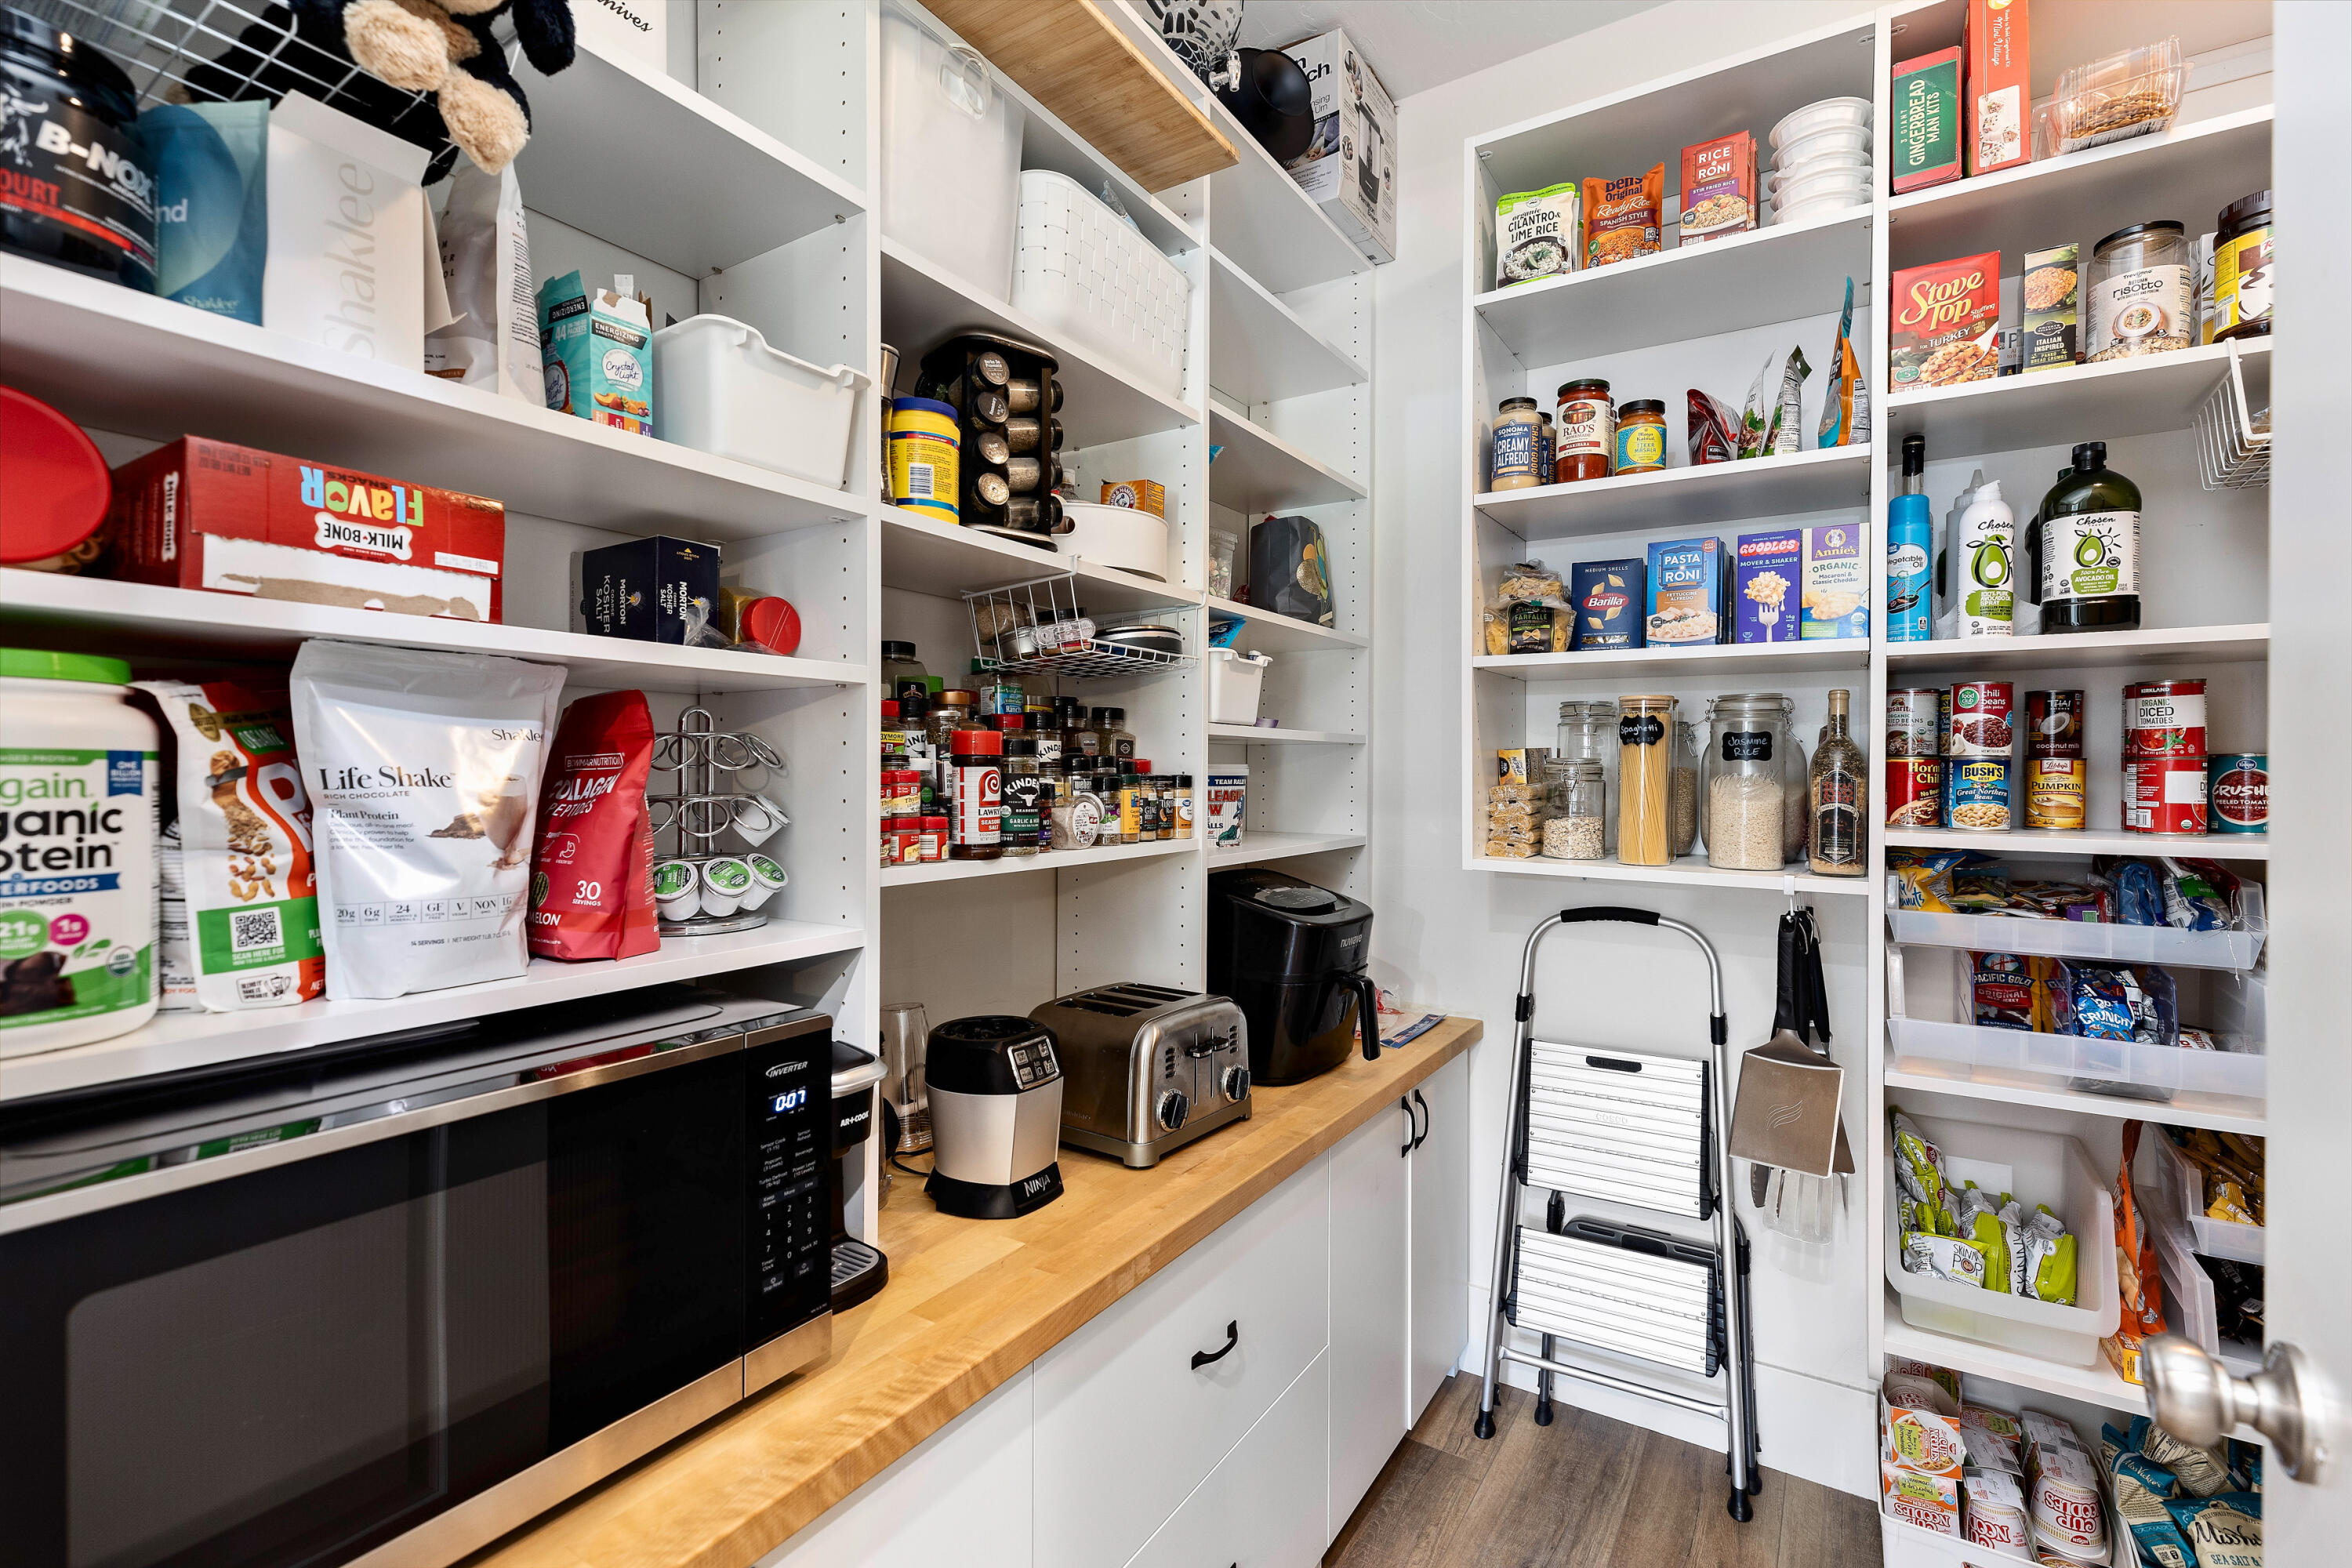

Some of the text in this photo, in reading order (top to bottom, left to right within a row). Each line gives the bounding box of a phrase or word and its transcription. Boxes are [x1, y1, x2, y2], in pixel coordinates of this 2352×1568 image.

[597, 0, 653, 32] nives
[1991, 16, 2004, 67] Mini Village
[1314, 102, 1328, 114] Urn
[1908, 78, 1926, 167] GINGERBREAD
[1926, 91, 1940, 144] MAN KITS
[1698, 147, 1731, 165] RICE
[1698, 162, 1731, 180] RONI
[0, 169, 61, 206] OURT
[1605, 185, 1643, 202] Original
[1704, 183, 1722, 192] FRIED
[1512, 207, 1542, 222] organic
[1597, 196, 1652, 218] Ready Rice
[1508, 211, 1555, 233] CILANTRO
[1599, 210, 1649, 227] SPANISH STYLE
[1511, 221, 1559, 244] LIME RICE
[323, 162, 376, 361] Shaklee
[2128, 277, 2149, 286] AUTUMN
[2112, 280, 2164, 299] risotto
[1900, 271, 1984, 325] Stove
[552, 300, 586, 319] ENERGIZING
[1927, 297, 1973, 332] Top
[1969, 302, 1996, 318] Stuffing
[1972, 313, 1985, 321] Mix
[555, 324, 566, 342] 44
[594, 322, 640, 343] ENERGIZING
[1929, 325, 1972, 349] TURKEY
[2034, 342, 2065, 354] INSPIRED
[2036, 336, 2063, 347] ITALIAN
[2048, 354, 2068, 362] CRUMBS
[605, 360, 636, 376] Crystal
[1498, 426, 1529, 436] SONOMA
[1563, 423, 1595, 437] RAO'S
[1497, 437, 1530, 453] CREAMY
[1530, 425, 1540, 474] CRAZY GOOD
[1497, 452, 1530, 467] ALFREDO
[325, 470, 389, 490] SNACKS
[1978, 519, 2015, 531] Chosen
[2076, 516, 2116, 526] Chosen
[1739, 539, 1798, 554] GOODLES
[1814, 546, 1857, 560] Annie's
[1664, 552, 1701, 566] PASTA
[1740, 556, 1798, 568] MOVER SHAKER
[1812, 561, 1859, 574] ORGANIC
[1665, 568, 1701, 583] RONI
[1833, 576, 1859, 585] Cheddar
[2074, 575, 2105, 583] AVOCADO
[679, 581, 688, 621] MORTON
[1588, 596, 1626, 608] Barilla
[1514, 612, 1548, 622] FARFALLE
[1981, 689, 2001, 698] chili
[1981, 697, 2007, 706] beans
[2141, 698, 2171, 706] ORGANIC
[2140, 706, 2175, 717] DICED
[2140, 717, 2174, 725] TOMATOES
[887, 732, 906, 741] MORE
[1620, 724, 1659, 736] Spaghetti
[1727, 735, 1769, 749] Jasmine
[1733, 746, 1760, 757] RICE
[116, 760, 139, 770] ONE
[1963, 766, 2004, 779] BUSH'S
[2045, 761, 2070, 770] Libby's
[319, 765, 453, 791] Life Shake
[0, 773, 89, 808] gain
[549, 772, 622, 801] COLLAGEN
[1956, 786, 2008, 797] Great Northern
[2031, 781, 2082, 791] PUMPKIN
[348, 790, 412, 800] CHOCOLATE
[330, 808, 400, 820] Plant Protein
[545, 798, 594, 818] PEPTIDES
[0, 837, 113, 873] otein
[0, 877, 100, 896] ERFOODS
[575, 880, 601, 900] 30
[395, 904, 411, 914] 24
[426, 902, 445, 913] GF
[474, 899, 497, 911] NON
[572, 898, 602, 907] SERVINGS
[59, 917, 82, 933] 1g
[418, 938, 446, 947] SERVINGS
[251, 949, 269, 960] HERE
[269, 947, 285, 956] FOR
[1973, 974, 2032, 986] PACIFIC GOLD
[1977, 988, 2028, 999] ORIGINAL
[2078, 1012, 2135, 1029] CRUNCHY
[768, 1061, 809, 1078] INVERTER
[1023, 1174, 1051, 1198] NINJA
[1951, 1254, 1983, 1276] POP
[1929, 1427, 1940, 1462] NOODLES
[1939, 1437, 1948, 1457] CUP
[1894, 1502, 1951, 1528] NOODLES
[2056, 1515, 2096, 1534] CUP
[2194, 1521, 2237, 1545] Miss
[2210, 1554, 2249, 1566] SEA SALT
